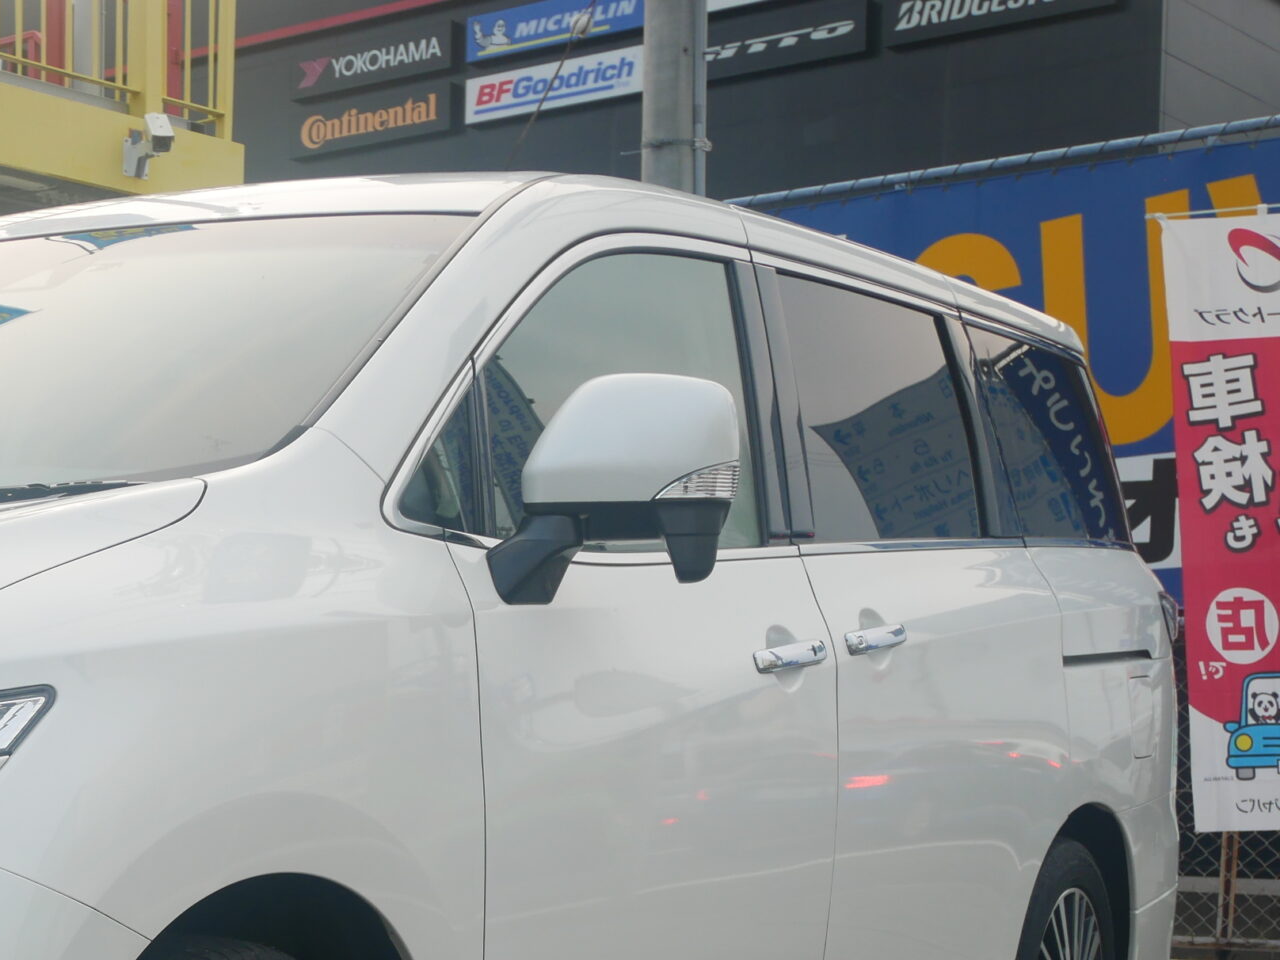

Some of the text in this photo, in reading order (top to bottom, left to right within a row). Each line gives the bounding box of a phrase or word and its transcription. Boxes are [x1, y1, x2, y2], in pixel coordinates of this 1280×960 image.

[514, 0, 636, 38] MICHLIN
[894, 0, 1057, 32] BRIDG
[332, 37, 441, 79] YOKOHAMA
[475, 57, 634, 107] BFGoodrich
[300, 94, 437, 149] Continental
